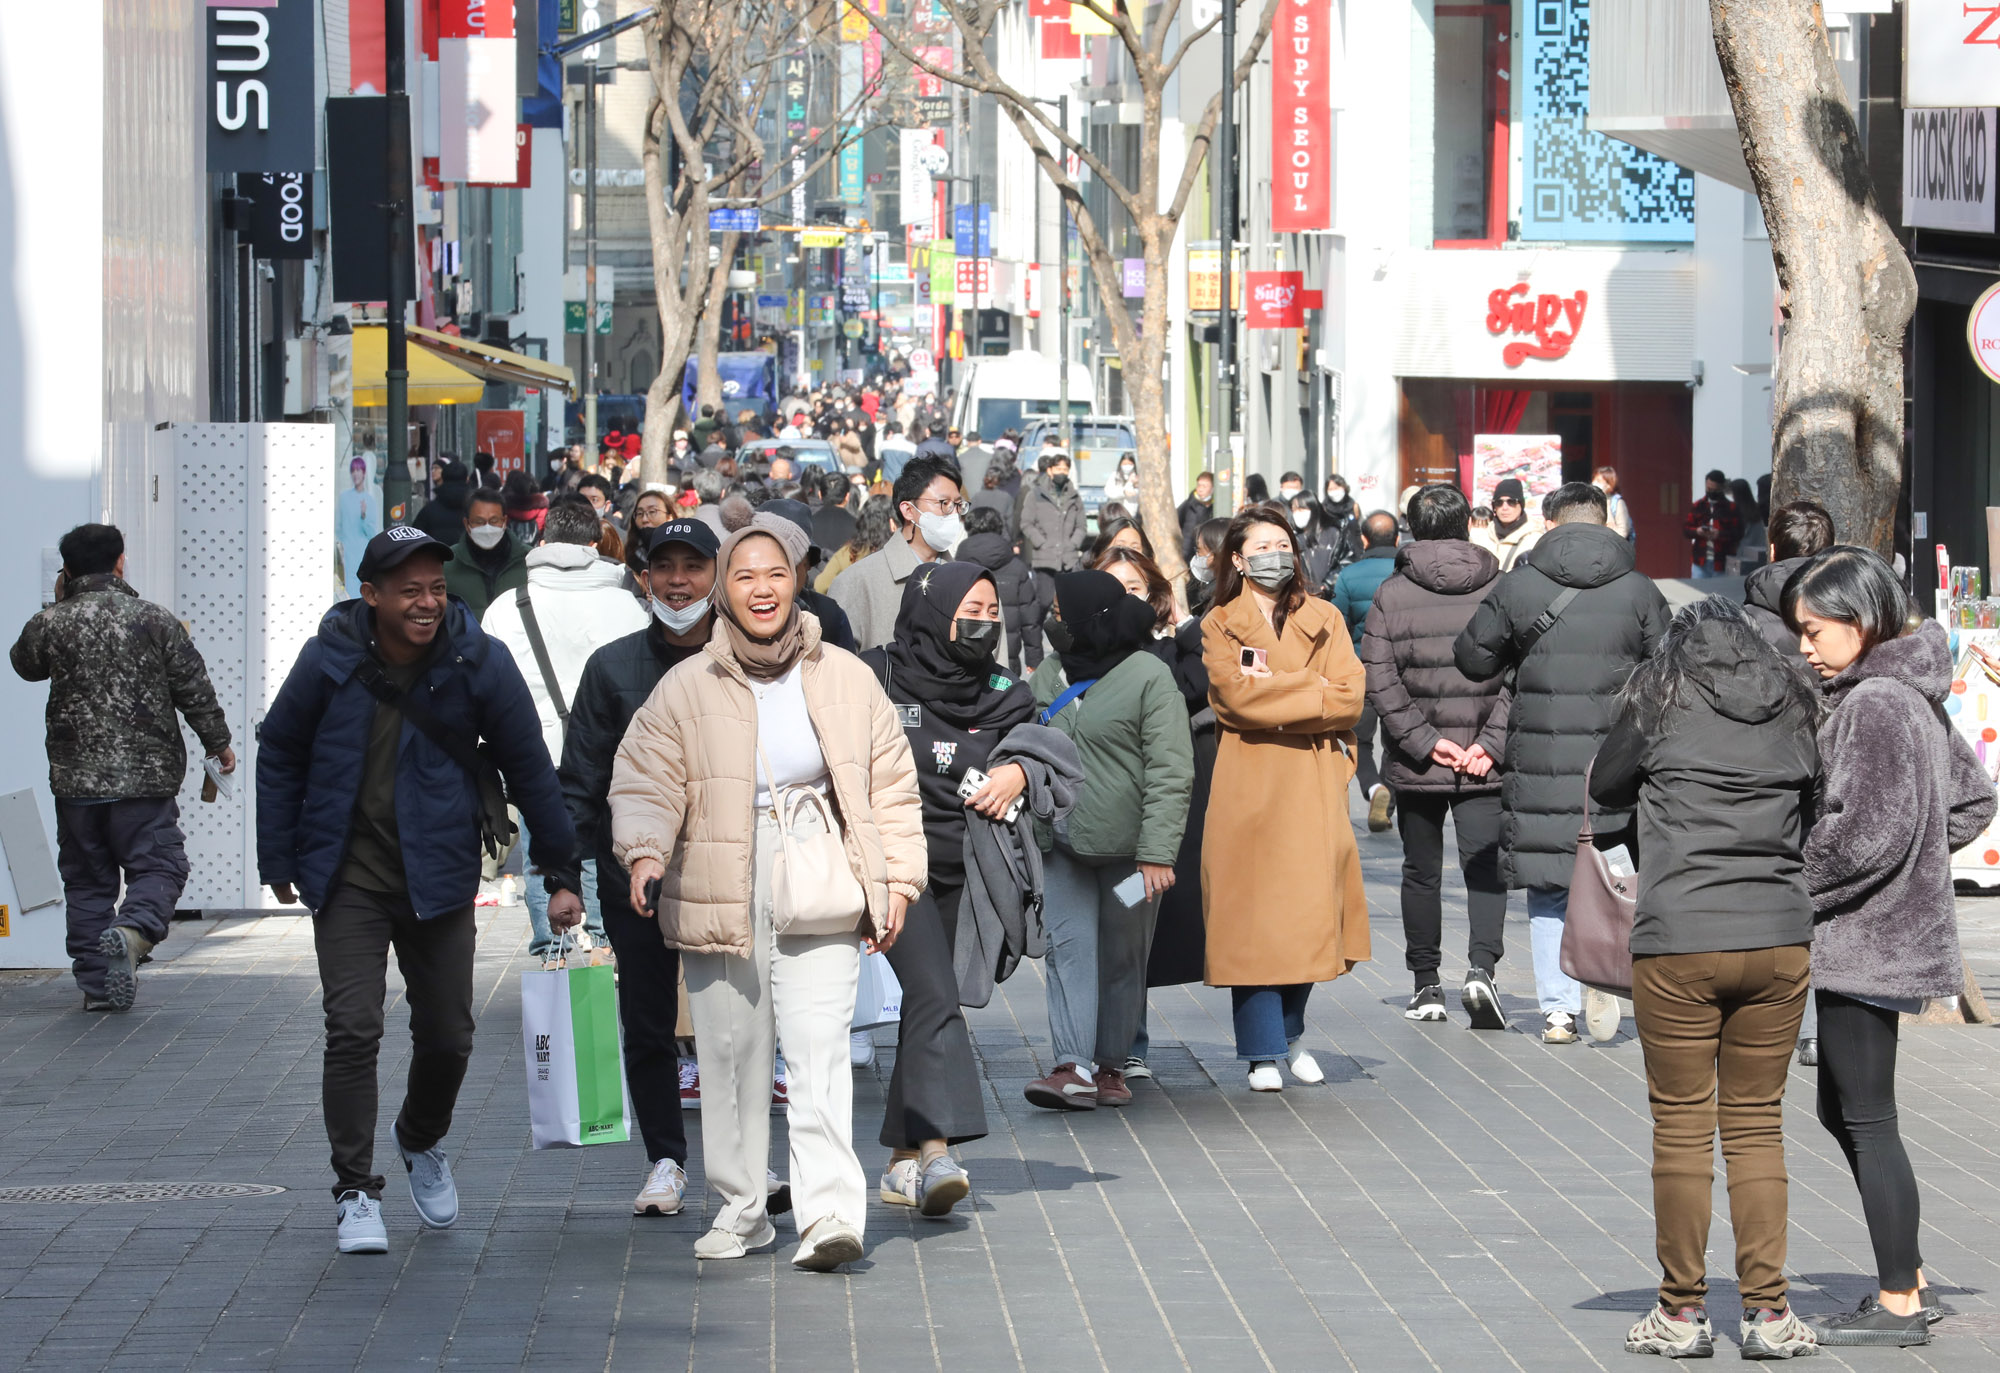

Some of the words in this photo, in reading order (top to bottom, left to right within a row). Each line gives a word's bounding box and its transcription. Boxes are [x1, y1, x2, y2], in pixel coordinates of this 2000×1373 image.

[1293, 16, 1310, 97] SUPY
[1292, 107, 1310, 211] SEOUL
[1254, 283, 1296, 311] Supy
[1486, 282, 1588, 367] Supy
[932, 741, 957, 755] JUST
[936, 753, 952, 766] DO
[536, 1034, 550, 1050] ABC
[536, 1052, 550, 1062] MART
